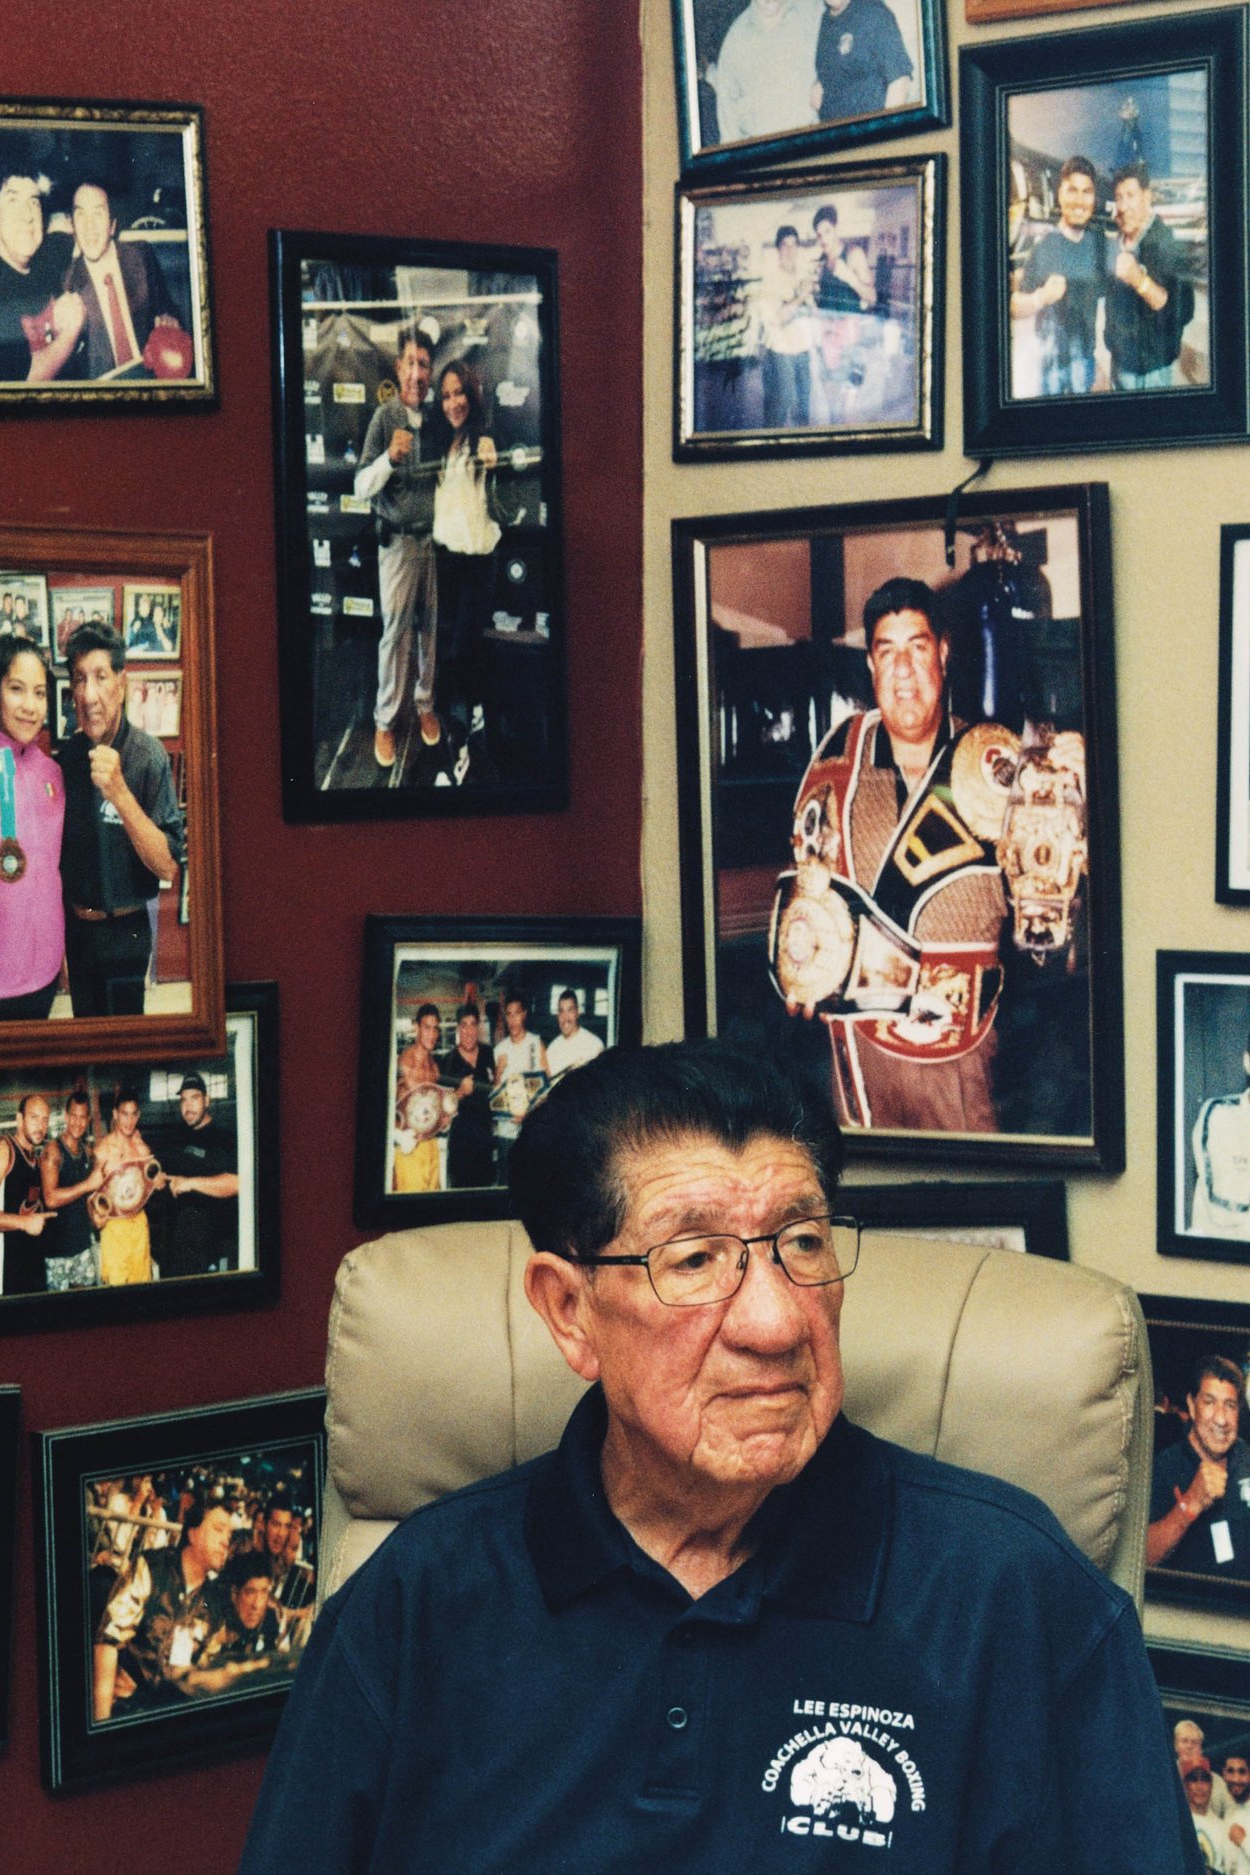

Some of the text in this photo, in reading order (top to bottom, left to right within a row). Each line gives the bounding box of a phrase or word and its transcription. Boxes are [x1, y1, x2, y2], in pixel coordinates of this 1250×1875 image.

[793, 1699, 915, 1730] LEE ESPINOZA
[761, 1720, 926, 1813] COACHELLA VALLEY BOXING
[786, 1816, 887, 1847] CLUB
